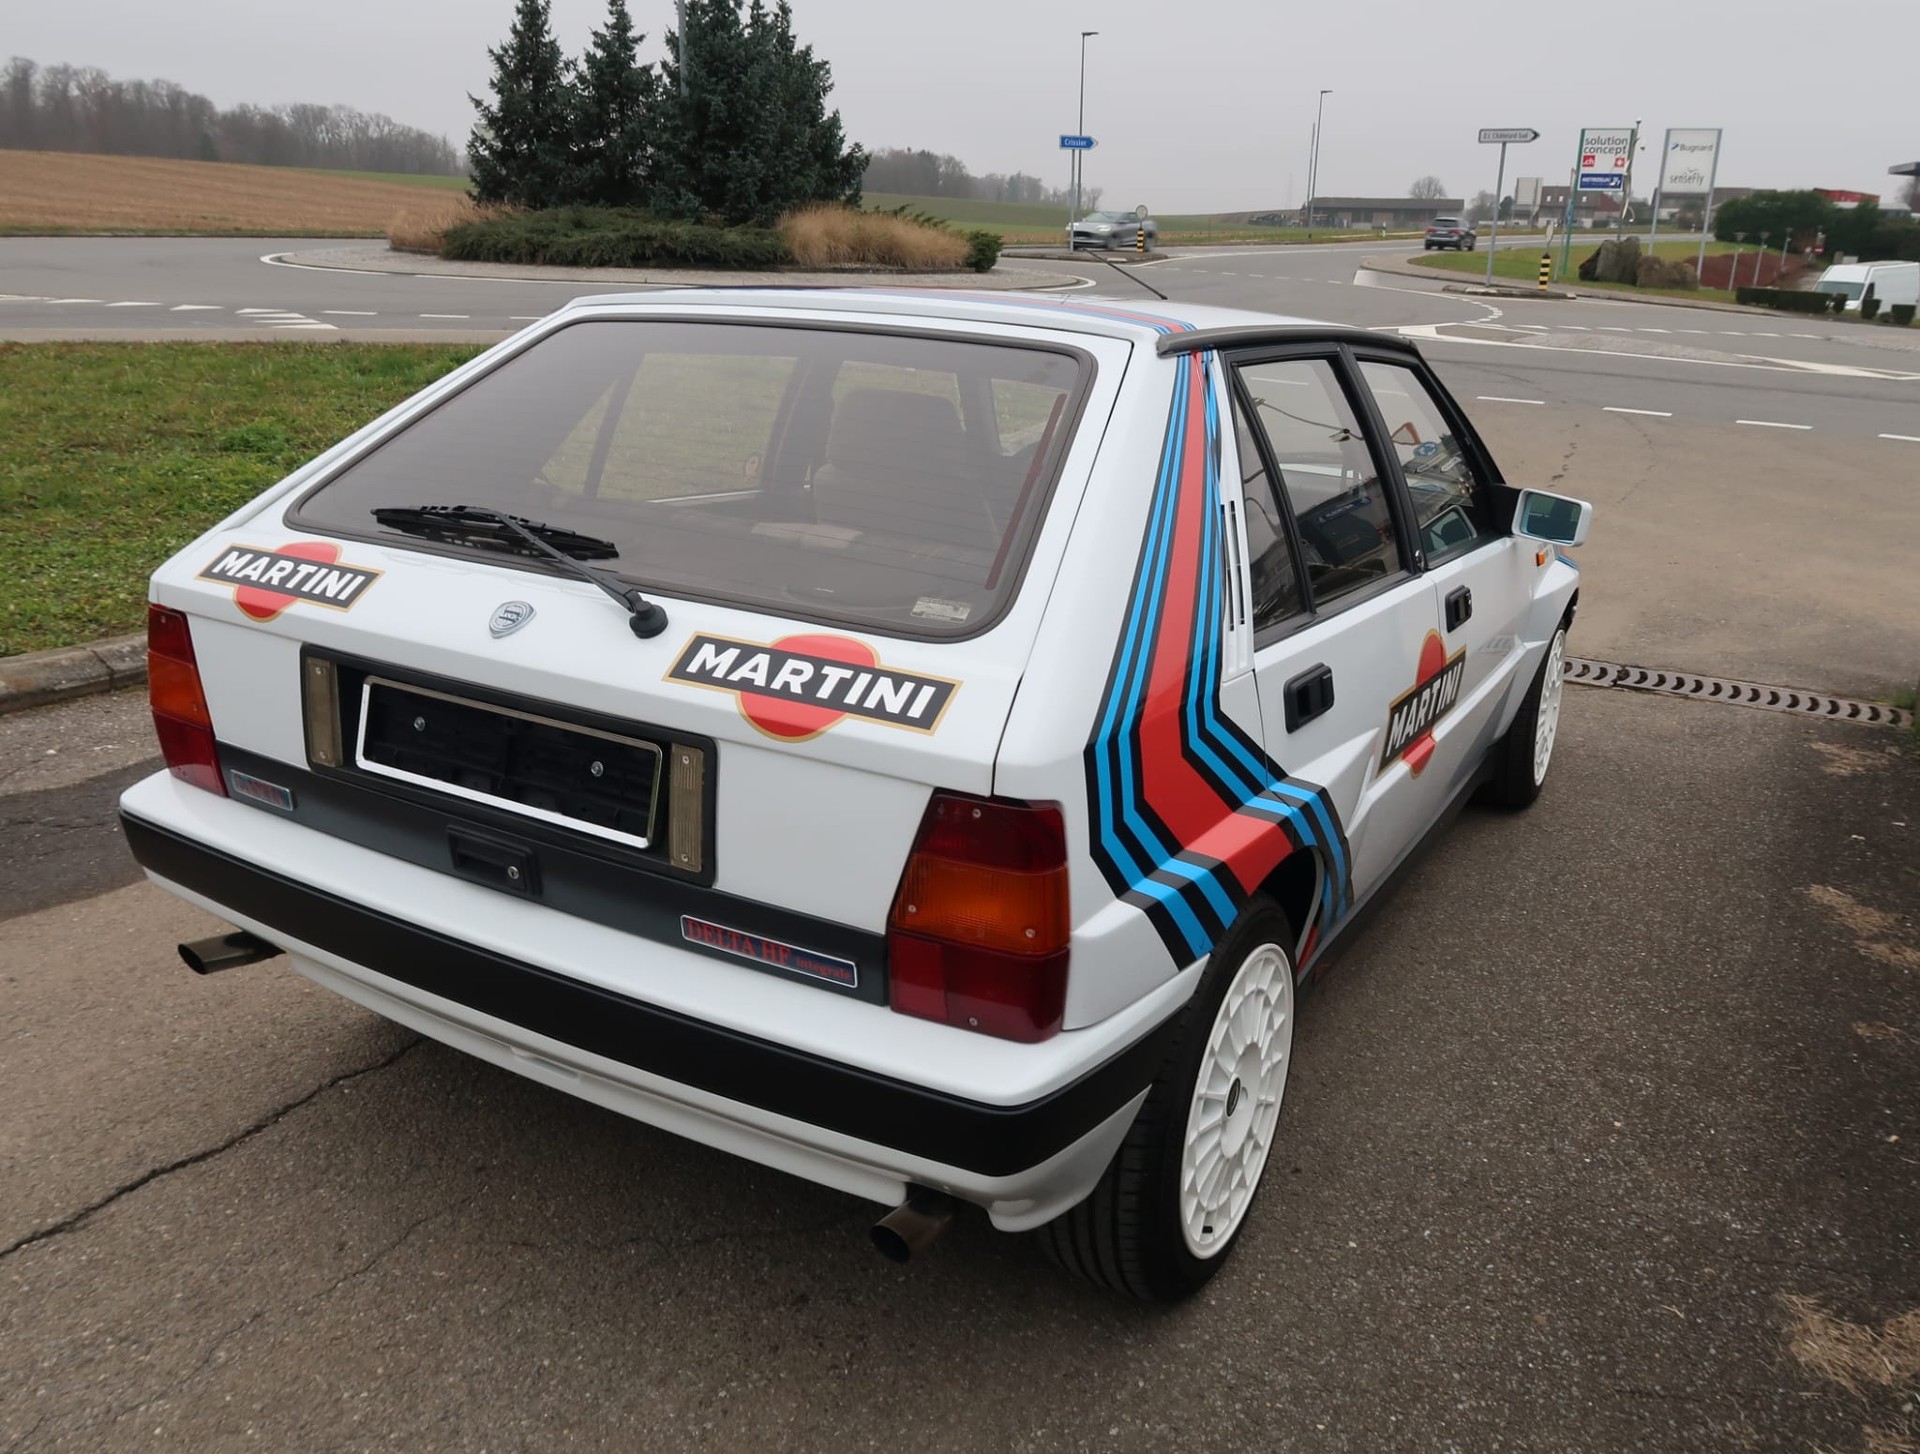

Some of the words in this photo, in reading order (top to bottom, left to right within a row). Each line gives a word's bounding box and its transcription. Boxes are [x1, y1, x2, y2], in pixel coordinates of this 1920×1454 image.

[1583, 145, 1627, 156] concept
[1585, 136, 1628, 146] solution
[211, 550, 366, 601] MARTINI
[685, 642, 936, 719] MARTINI
[1385, 660, 1463, 758] MARTINI
[687, 918, 756, 957] DELTA
[760, 941, 793, 967] HF
[796, 957, 853, 980] integrale
